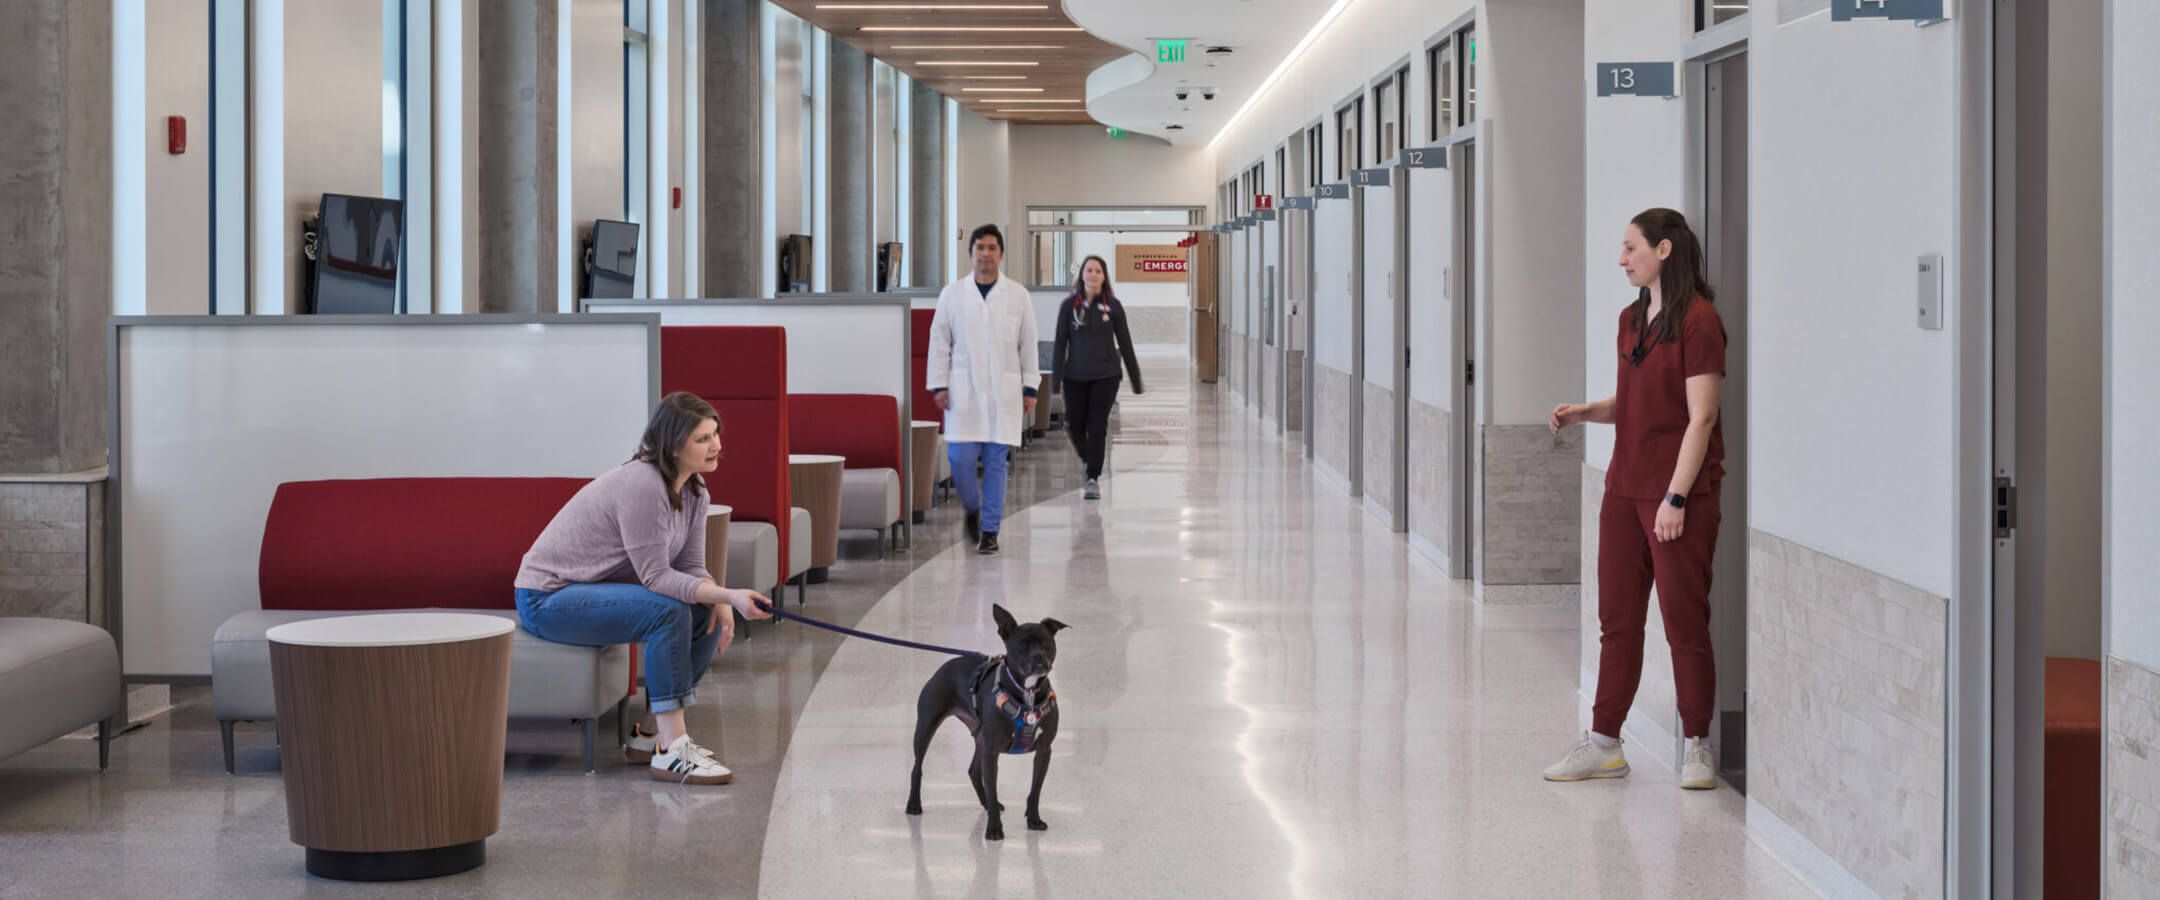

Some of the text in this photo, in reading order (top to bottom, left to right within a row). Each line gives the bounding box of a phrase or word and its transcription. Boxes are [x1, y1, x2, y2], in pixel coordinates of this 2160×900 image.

[1157, 40, 1187, 63] EXIT
[1610, 67, 1634, 89] 13
[1408, 151, 1423, 165] 12
[1359, 171, 1369, 184] 11
[1320, 186, 1332, 197] 10
[1289, 198, 1297, 208] 9
